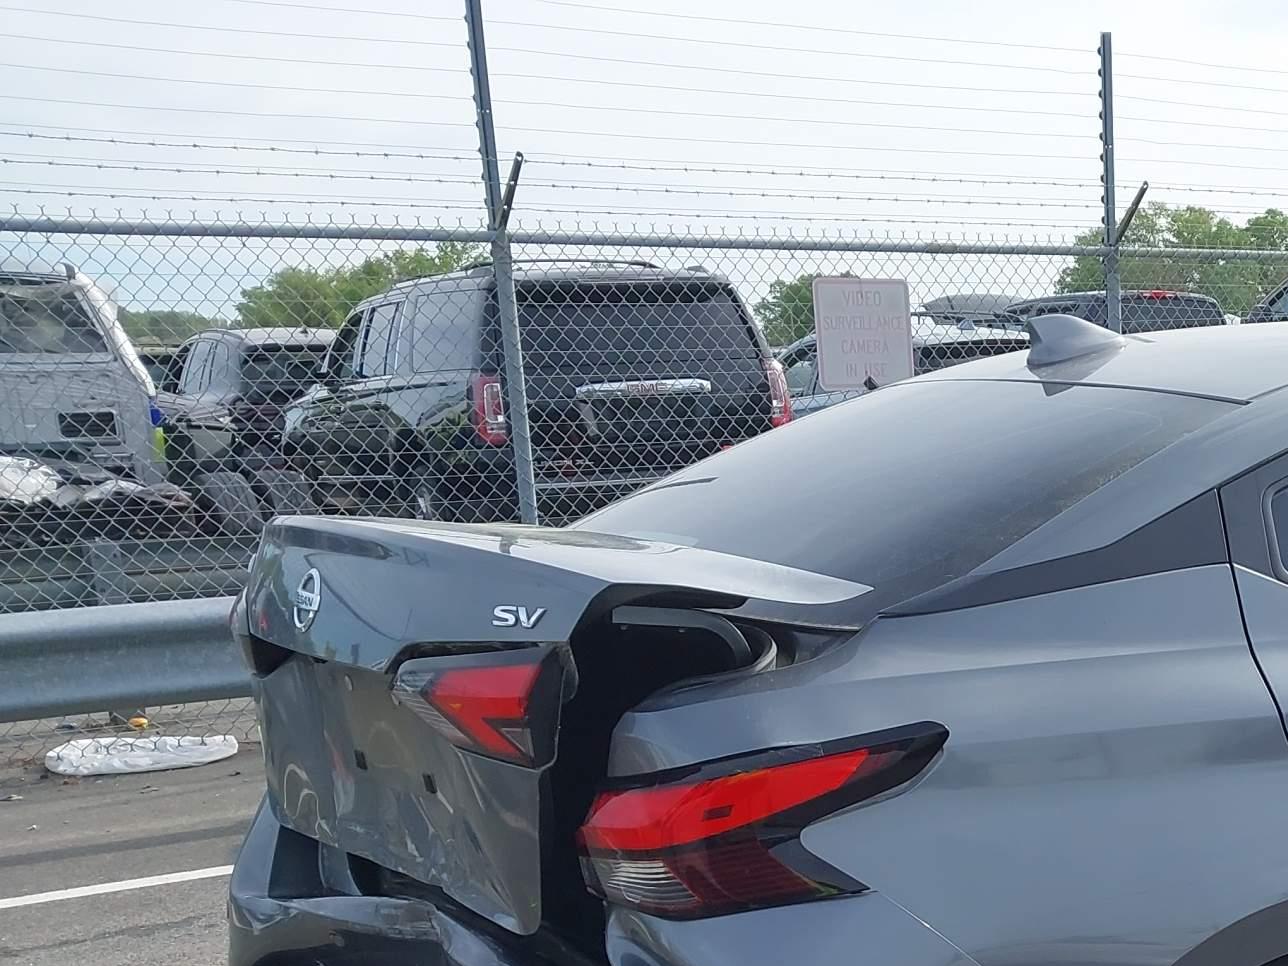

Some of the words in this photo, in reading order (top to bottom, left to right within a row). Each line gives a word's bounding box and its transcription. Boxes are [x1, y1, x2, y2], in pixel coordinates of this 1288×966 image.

[841, 290, 881, 306] VIDEO
[823, 315, 904, 331] SURVEILLANCE
[841, 338, 889, 354] CAMERA
[846, 362, 857, 377] IN
[864, 362, 889, 377] USE
[491, 605, 547, 629] SV
